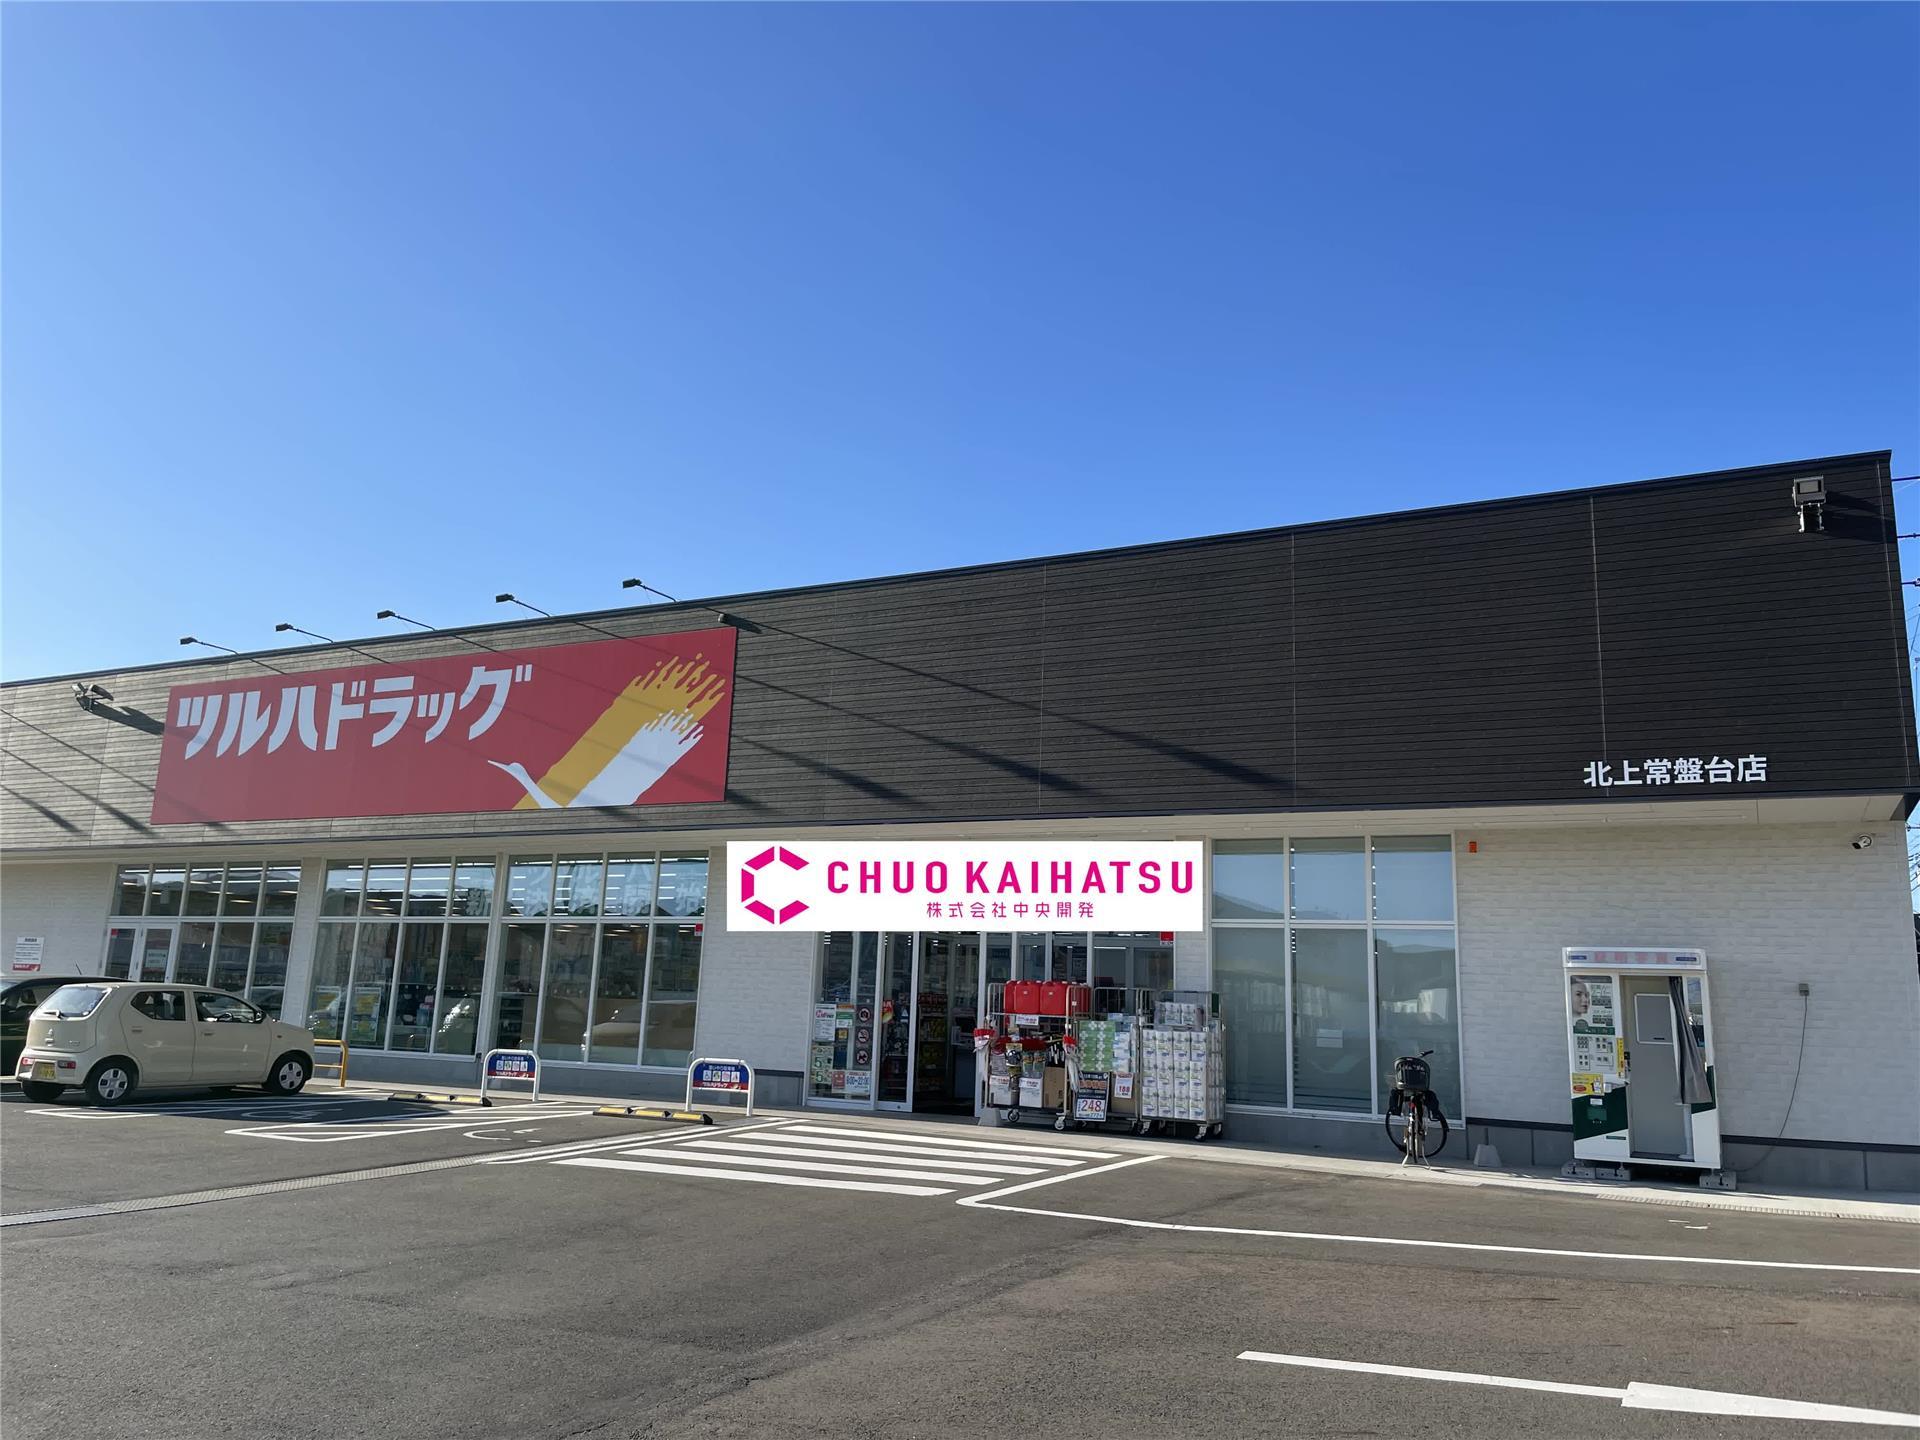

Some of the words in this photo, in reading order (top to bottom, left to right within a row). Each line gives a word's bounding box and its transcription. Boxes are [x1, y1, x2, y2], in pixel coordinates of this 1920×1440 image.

[177, 664, 532, 760] ツルハドラッグ
[1583, 754, 1767, 787] 北上常盤台店
[1081, 1099, 1102, 1112] 248
